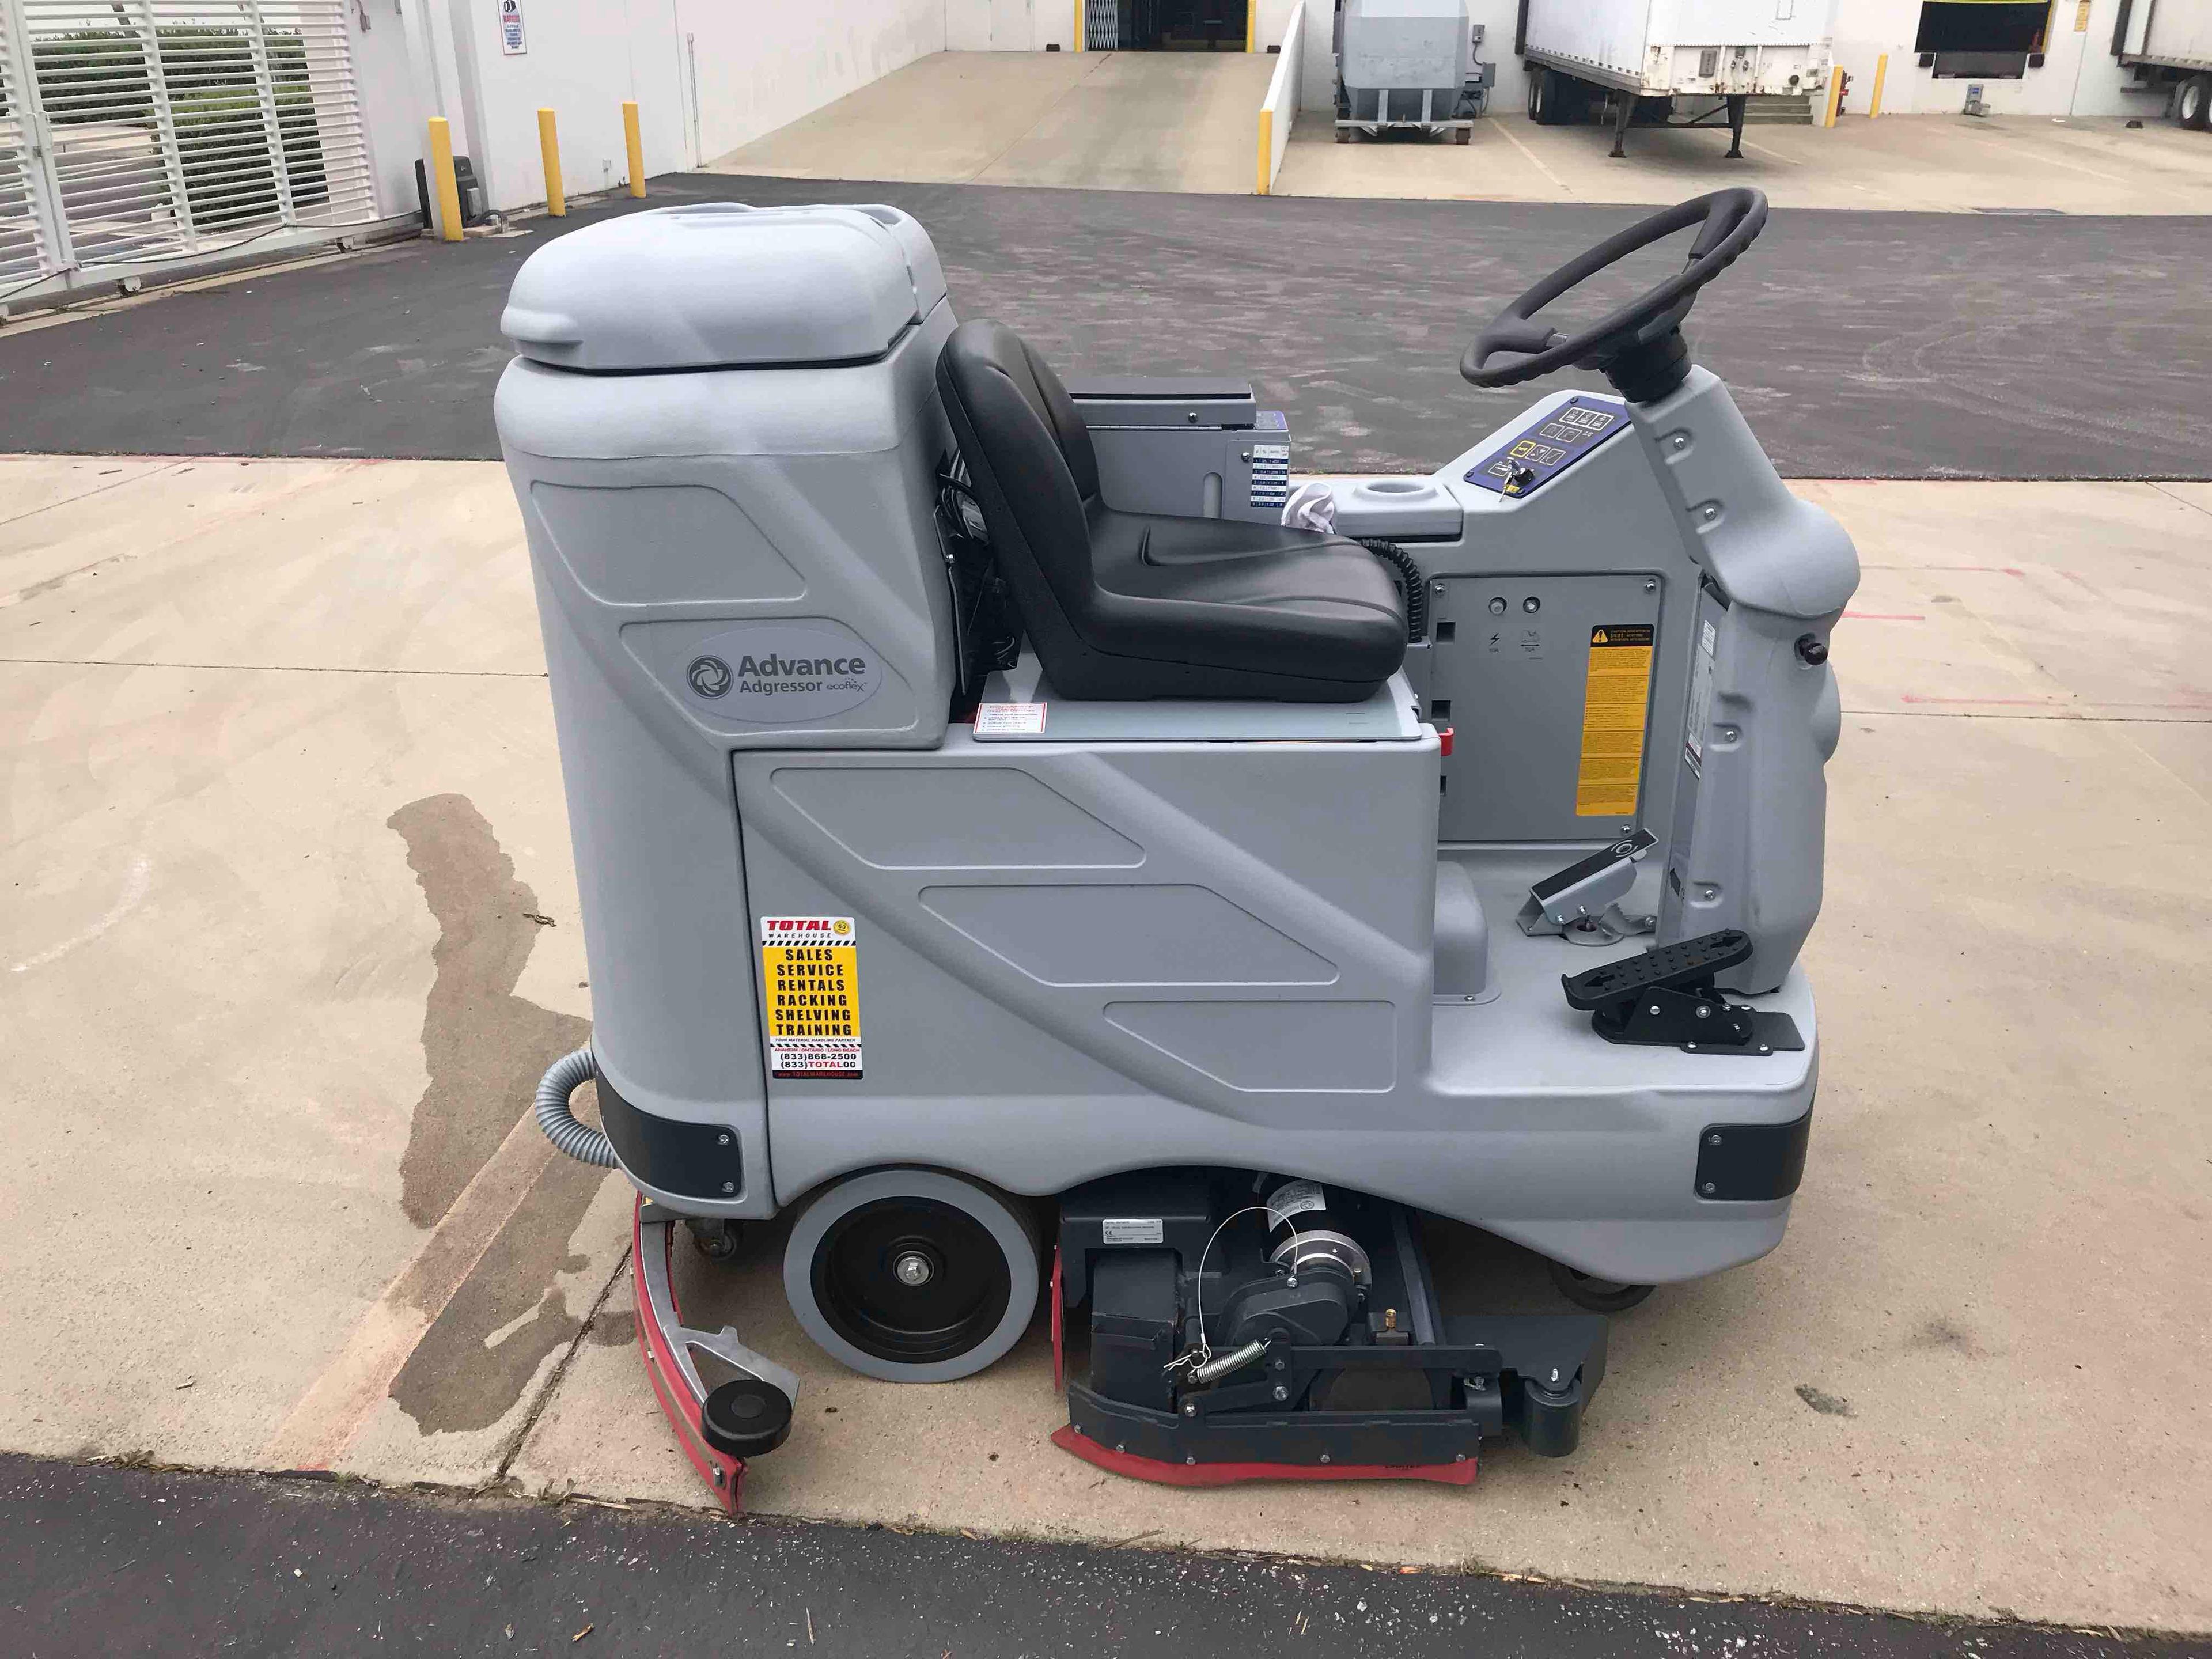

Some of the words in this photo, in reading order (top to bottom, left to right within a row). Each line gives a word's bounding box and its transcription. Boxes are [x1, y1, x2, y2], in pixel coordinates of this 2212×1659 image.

[737, 654, 866, 677] Advance
[740, 680, 823, 696] Adgressor
[767, 921, 831, 931] TOTAL
[785, 949, 833, 961] SALES
[777, 964, 844, 976] SERVICE
[778, 979, 845, 991] RENTALS
[777, 994, 847, 1006] RACKING
[775, 1009, 851, 1021] SHELVING
[776, 1024, 851, 1035] TRAINING
[780, 1053, 857, 1062] (833)868-2500
[781, 1061, 856, 1069] (833)TOTAL00
